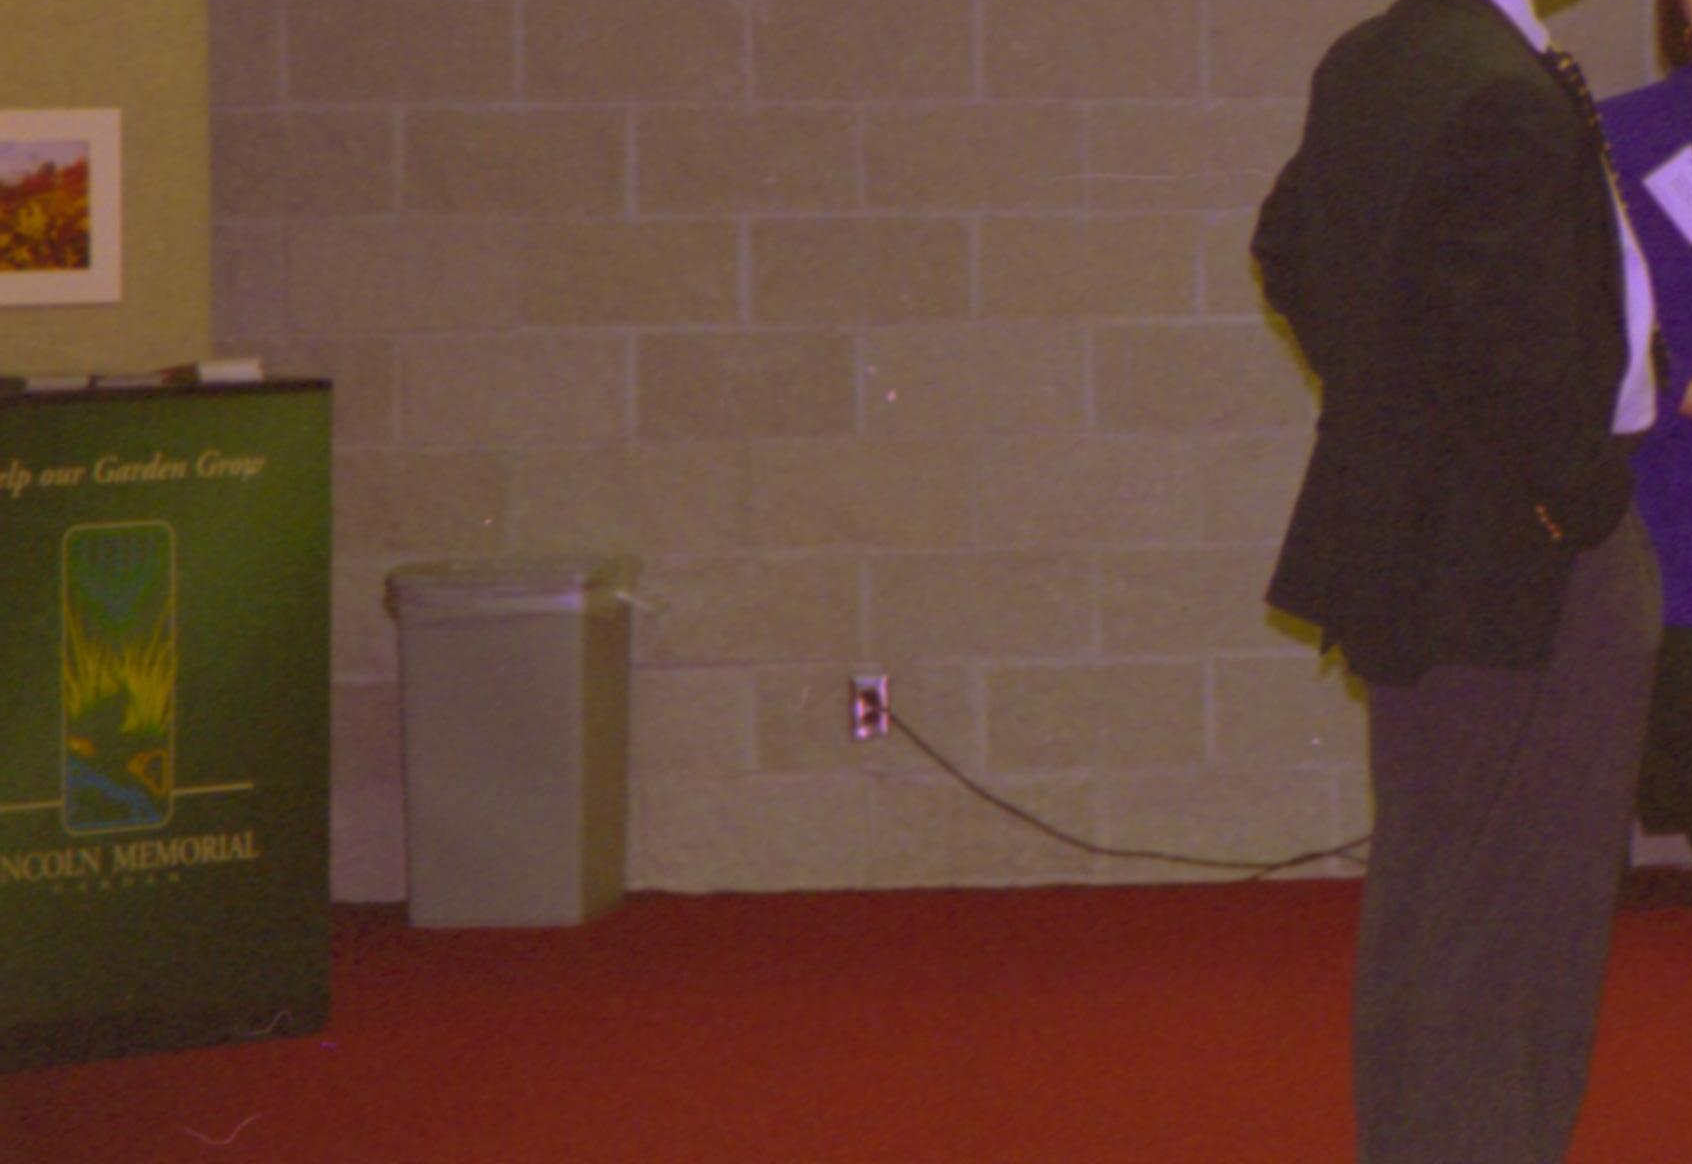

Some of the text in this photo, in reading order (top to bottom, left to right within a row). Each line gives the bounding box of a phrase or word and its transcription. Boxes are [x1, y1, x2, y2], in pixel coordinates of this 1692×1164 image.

[39, 465, 87, 487] our
[93, 452, 188, 485] Garden
[196, 449, 267, 481] Grow
[112, 830, 262, 873] MEMORIAL
